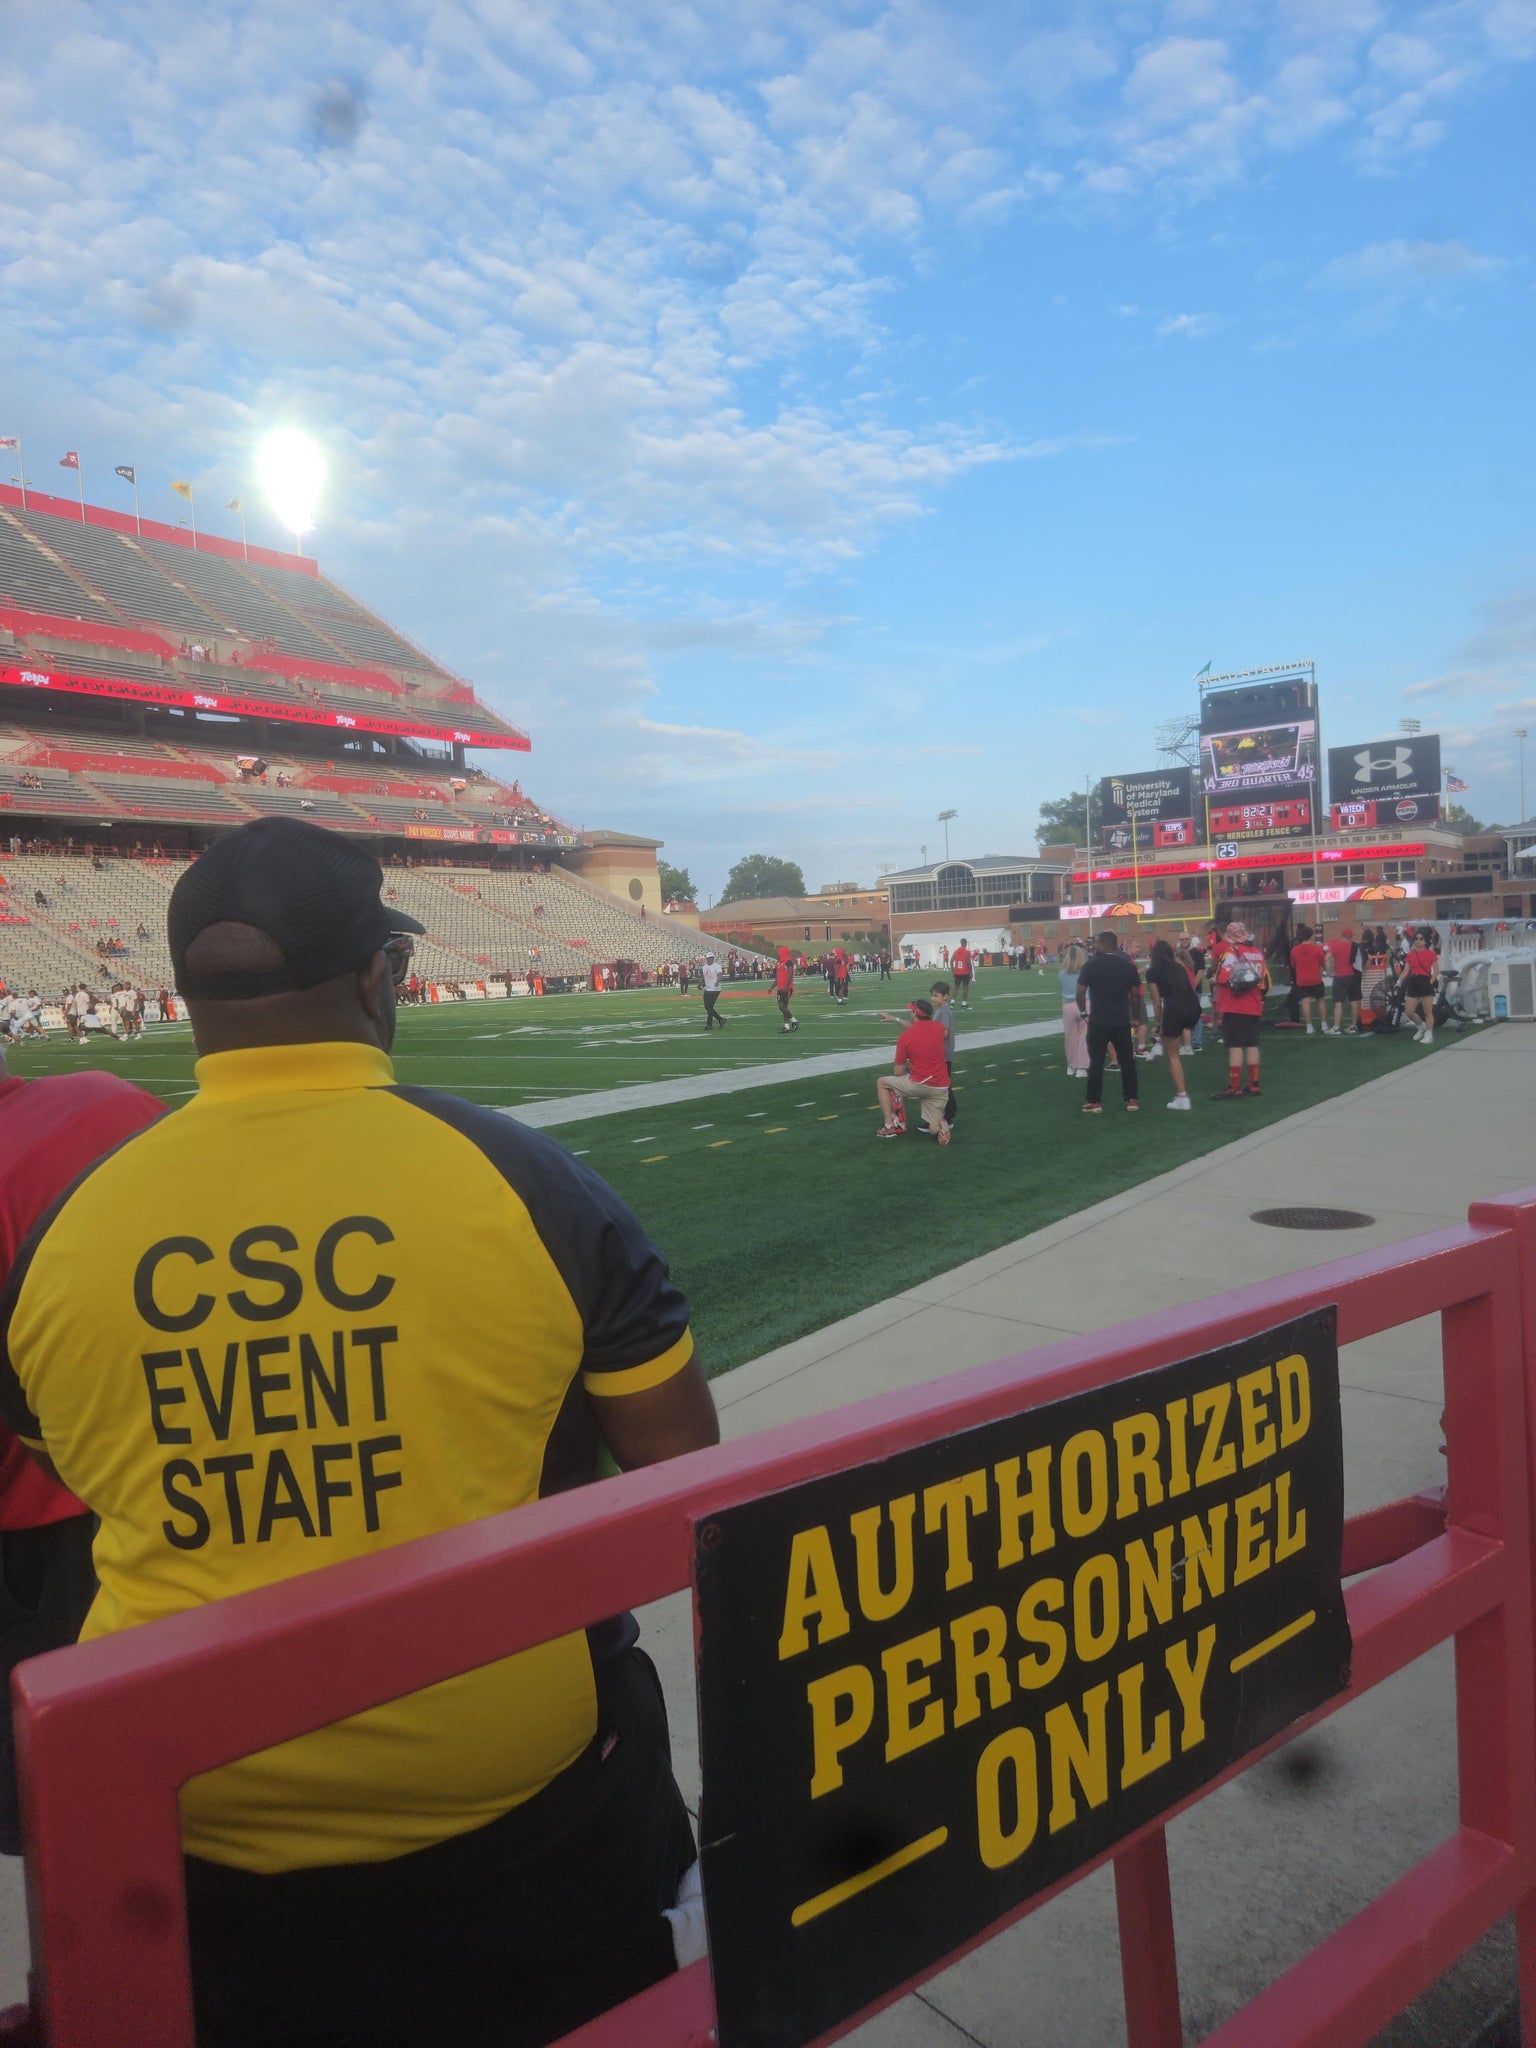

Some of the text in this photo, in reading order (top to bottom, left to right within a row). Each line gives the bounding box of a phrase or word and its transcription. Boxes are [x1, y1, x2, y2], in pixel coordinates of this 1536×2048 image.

[20, 671, 49, 686] Terps
[193, 695, 218, 708] Terps
[335, 715, 357, 727] Terps
[453, 731, 472, 743] Terps
[1126, 780, 1171, 792] University
[1203, 777, 1216, 791] 14
[1218, 779, 1239, 789] 3RD
[1242, 773, 1292, 786] QUARTER
[1126, 786, 1179, 801] of Maryland
[1351, 782, 1417, 794] UNDER ARMOUR
[1126, 798, 1161, 809] Medical
[1349, 804, 1365, 812] TECH
[1127, 807, 1159, 818] System
[1349, 815, 1355, 824] 0
[1227, 826, 1291, 840] HERCULES FENCE
[1219, 845, 1235, 857] 25
[1272, 841, 1288, 849] ACC
[134, 1215, 396, 1333] CSC
[142, 1325, 399, 1445] EVENT
[162, 1434, 403, 1550] STAFF
[778, 1354, 1311, 1661] AUTHORIZED
[807, 1471, 1306, 1799] PERSONNEL
[976, 1623, 1216, 1869] ONLY
